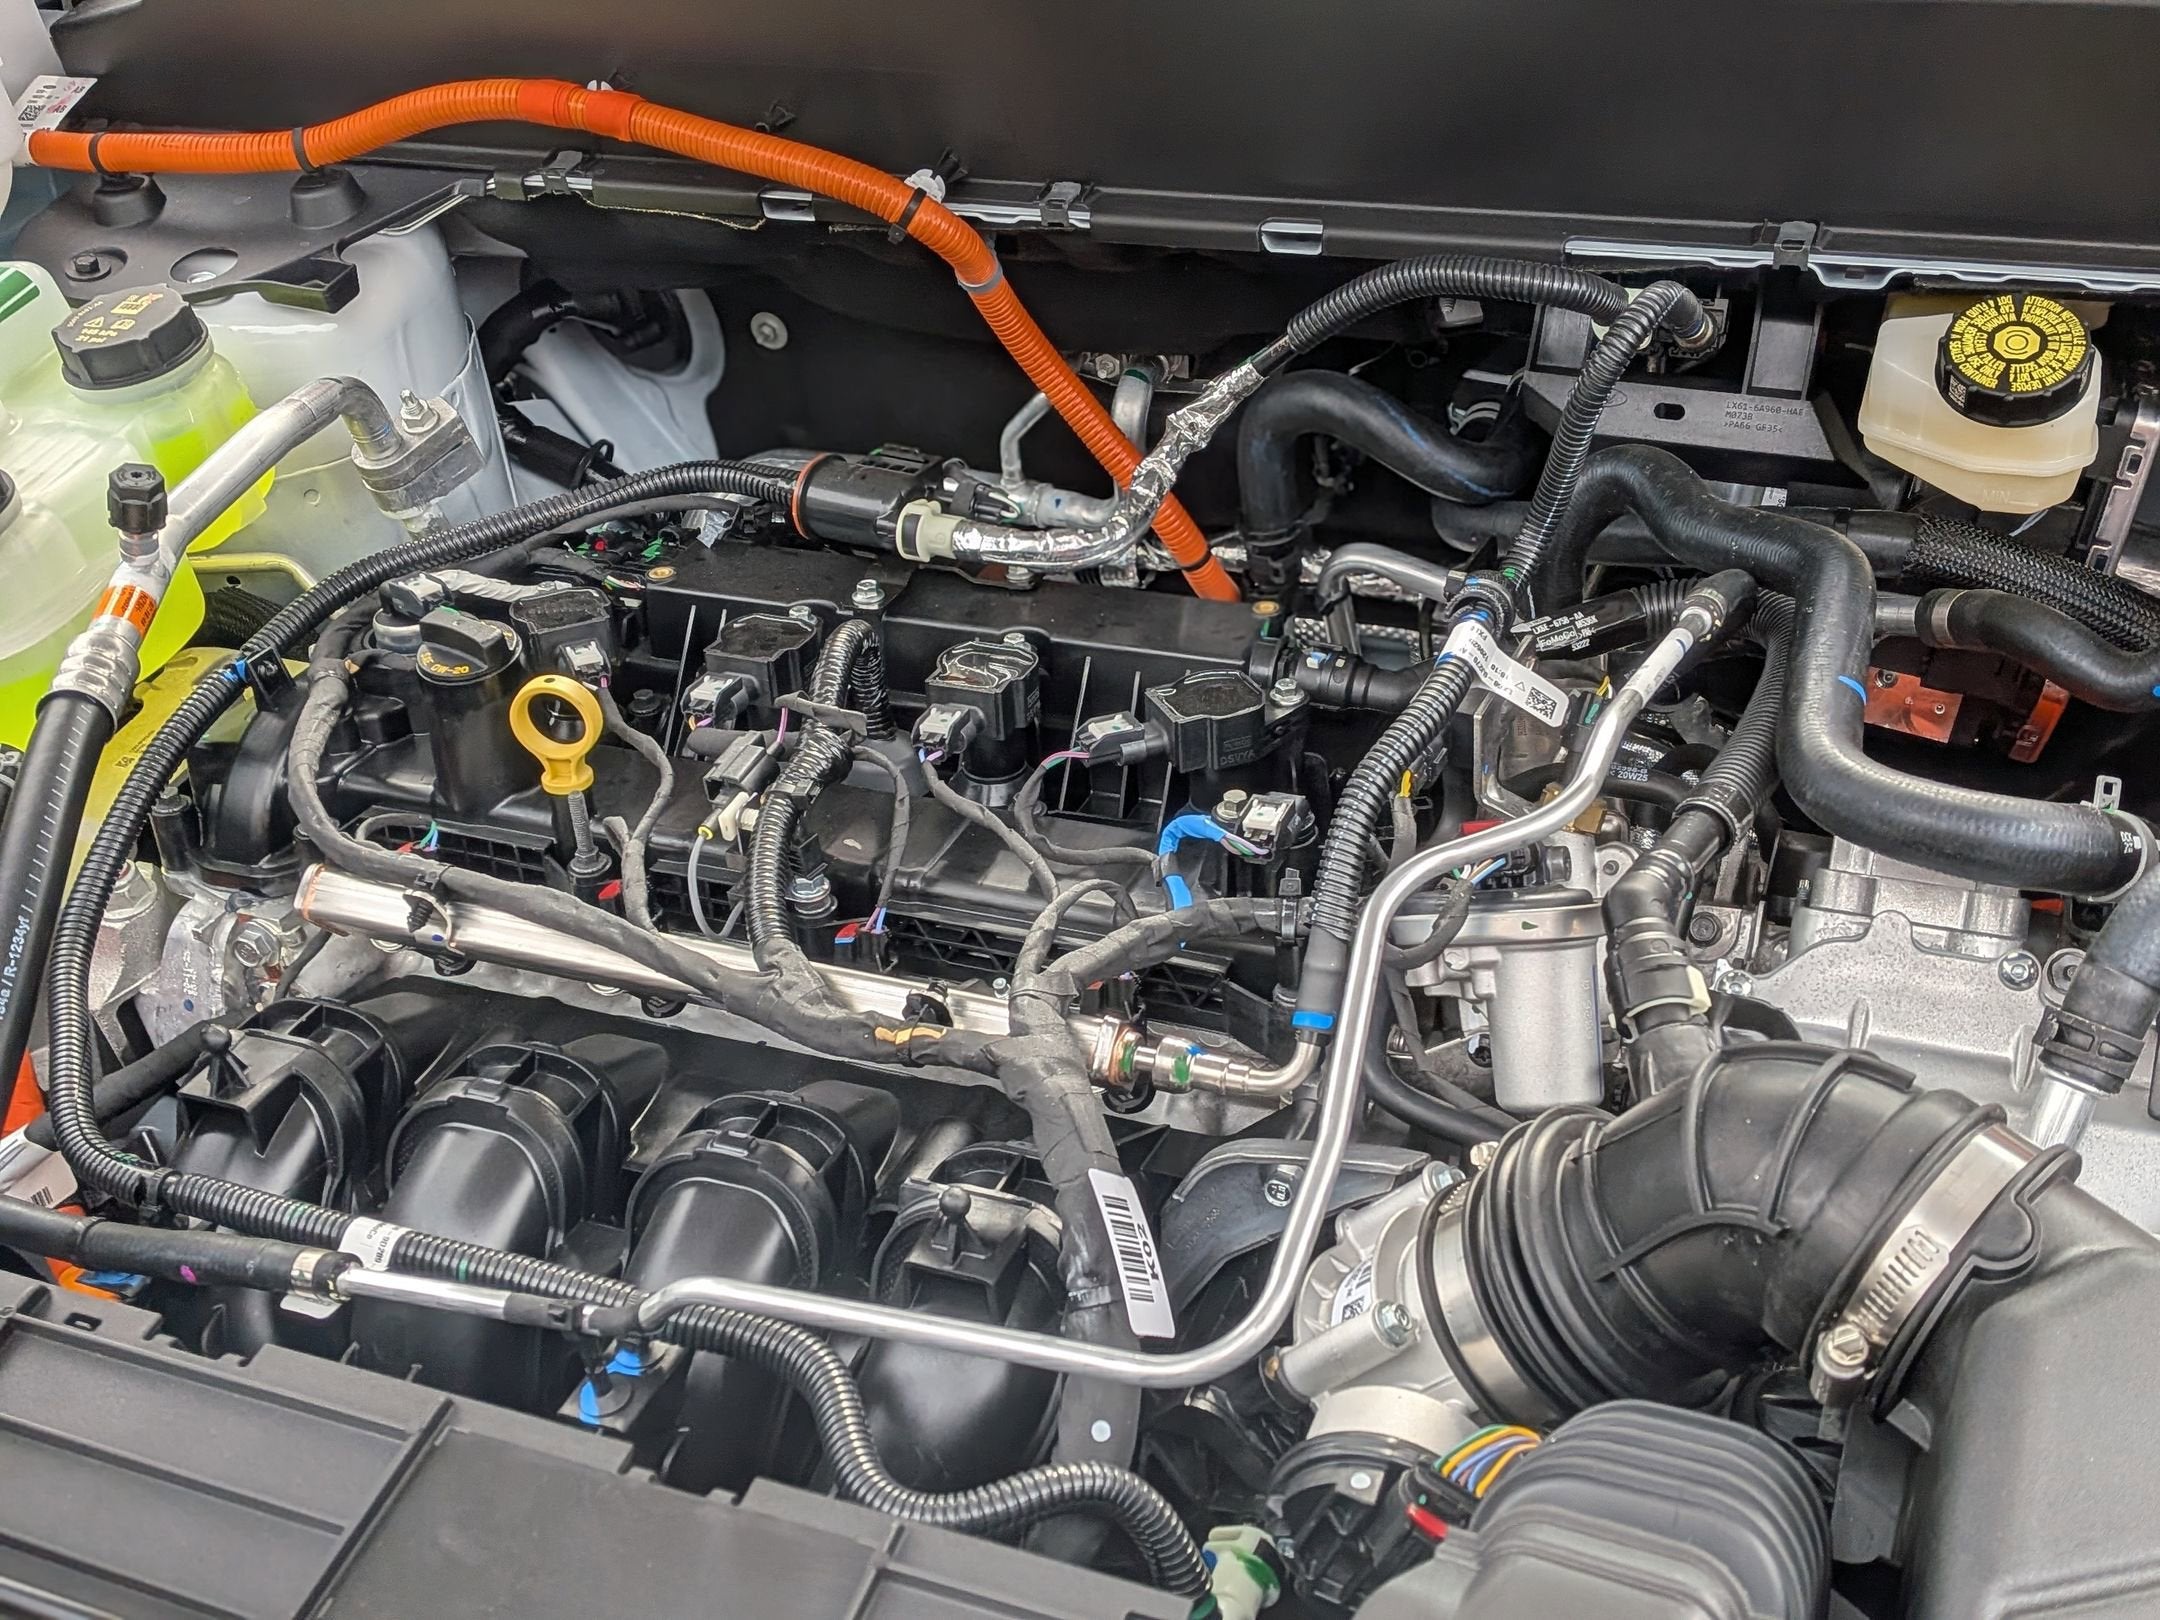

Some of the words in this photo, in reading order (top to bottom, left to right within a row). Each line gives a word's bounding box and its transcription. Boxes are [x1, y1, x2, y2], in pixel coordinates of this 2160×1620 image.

[1996, 294, 2013, 305] DOT
[2025, 295, 2065, 314] ATTENTION
[1966, 302, 1989, 318] FLUID
[2000, 304, 2015, 314] CAP
[1951, 316, 1971, 333] FROM
[1970, 308, 1999, 327] BEFORE
[1981, 312, 2017, 332] WARNING
[1974, 332, 1988, 352] CLEAN
[2060, 333, 2072, 341] DU
[2073, 337, 2086, 345] LE
[1949, 341, 1966, 363] SEALED
[1967, 355, 1984, 368] USE
[1979, 352, 2006, 371] FILLER
[2009, 361, 2038, 373] SCELLE
[2048, 360, 2062, 370] DE
[1959, 363, 1998, 389] CONTAINER
[1980, 365, 2001, 378] ONLY
[2016, 372, 2031, 382] DOT
[2031, 365, 2053, 380] FREIN
[2043, 369, 2067, 386] AVANT
[2010, 380, 2042, 392] DEPOSE
[1540, 630, 1577, 647] FoMoCo
[430, 663, 470, 674] 0W-20
[1617, 770, 1649, 782] 20W25
[1137, 1223, 1160, 1281] K02
